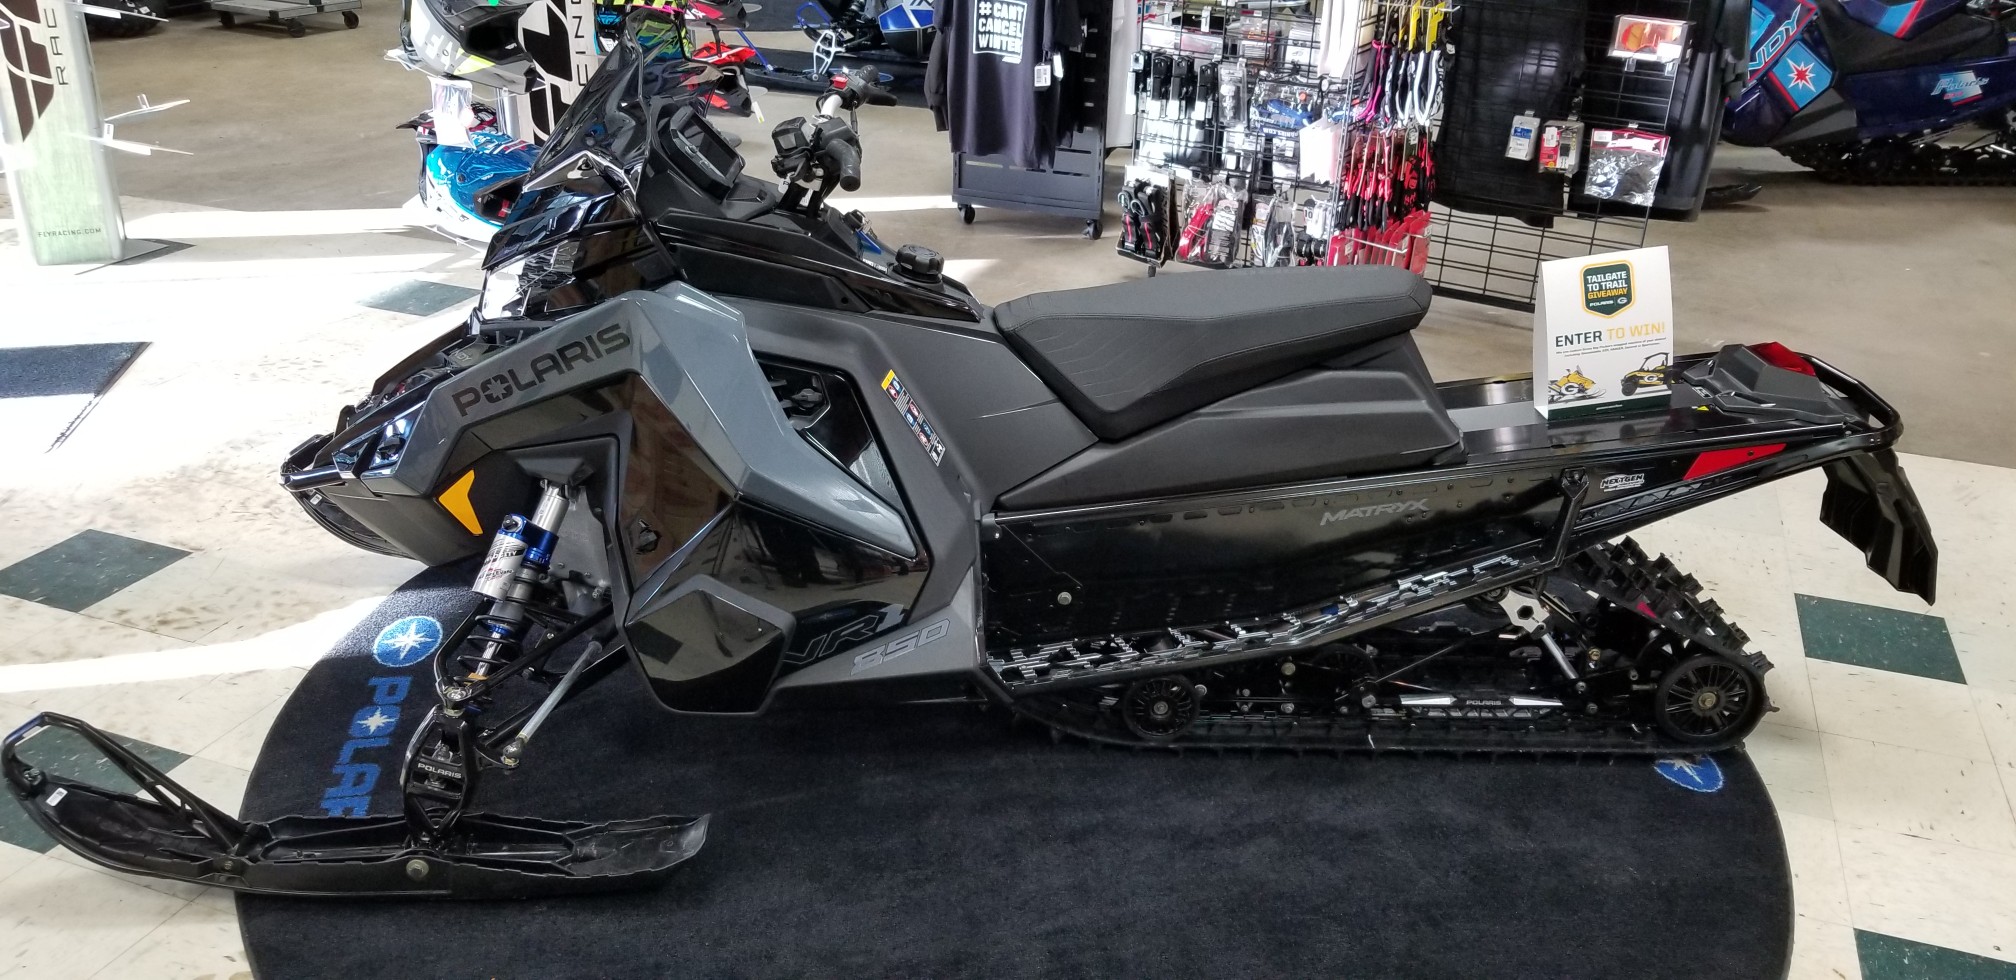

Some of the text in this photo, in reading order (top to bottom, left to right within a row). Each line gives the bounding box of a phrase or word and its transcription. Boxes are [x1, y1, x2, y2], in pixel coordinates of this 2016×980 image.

[978, 17, 1023, 38] CANCEL
[978, 33, 1022, 54] WINTER
[38, 228, 102, 238] FLYRACING.COM
[1586, 270, 1628, 283] TAILGATE
[1587, 279, 1628, 292] TO TRAIL
[1587, 287, 1628, 300] GIVEAWAY
[1555, 330, 1603, 348] ENTER
[1607, 327, 1625, 340] TO
[1630, 322, 1666, 337] WIN!
[452, 323, 631, 417] POLARIS
[1320, 498, 1430, 526] MATRYX
[850, 618, 950, 677] 850
[417, 762, 462, 779] POLARIS
